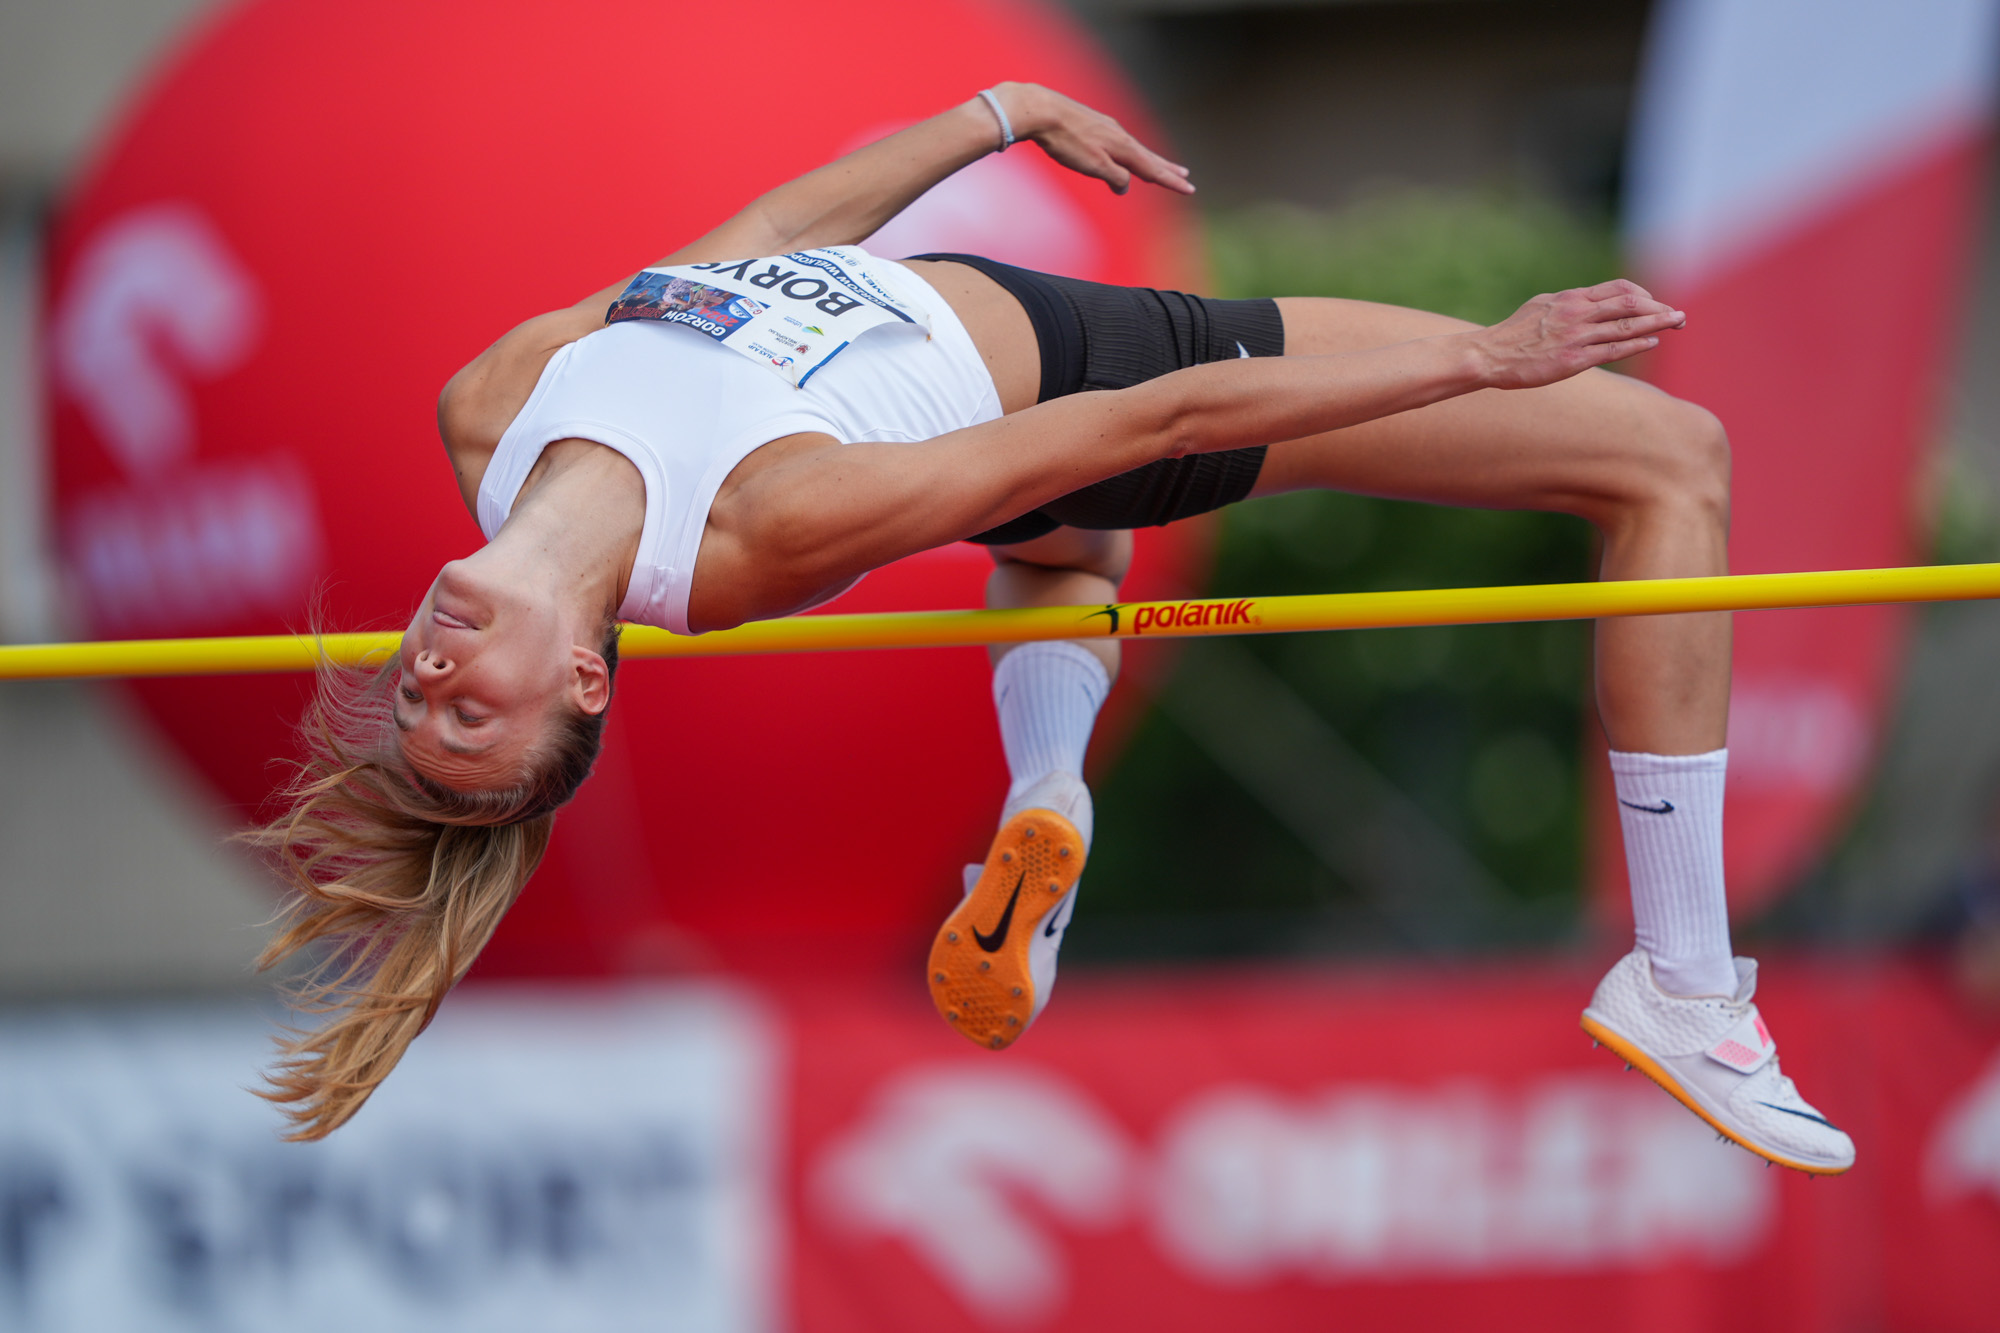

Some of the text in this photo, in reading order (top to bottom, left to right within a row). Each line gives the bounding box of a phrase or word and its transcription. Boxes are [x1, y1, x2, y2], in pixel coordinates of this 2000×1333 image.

[859, 272, 895, 302] TAMEX
[661, 310, 726, 336] GORZÓW
[698, 307, 739, 327] 2024
[1134, 598, 1256, 635] polanik
